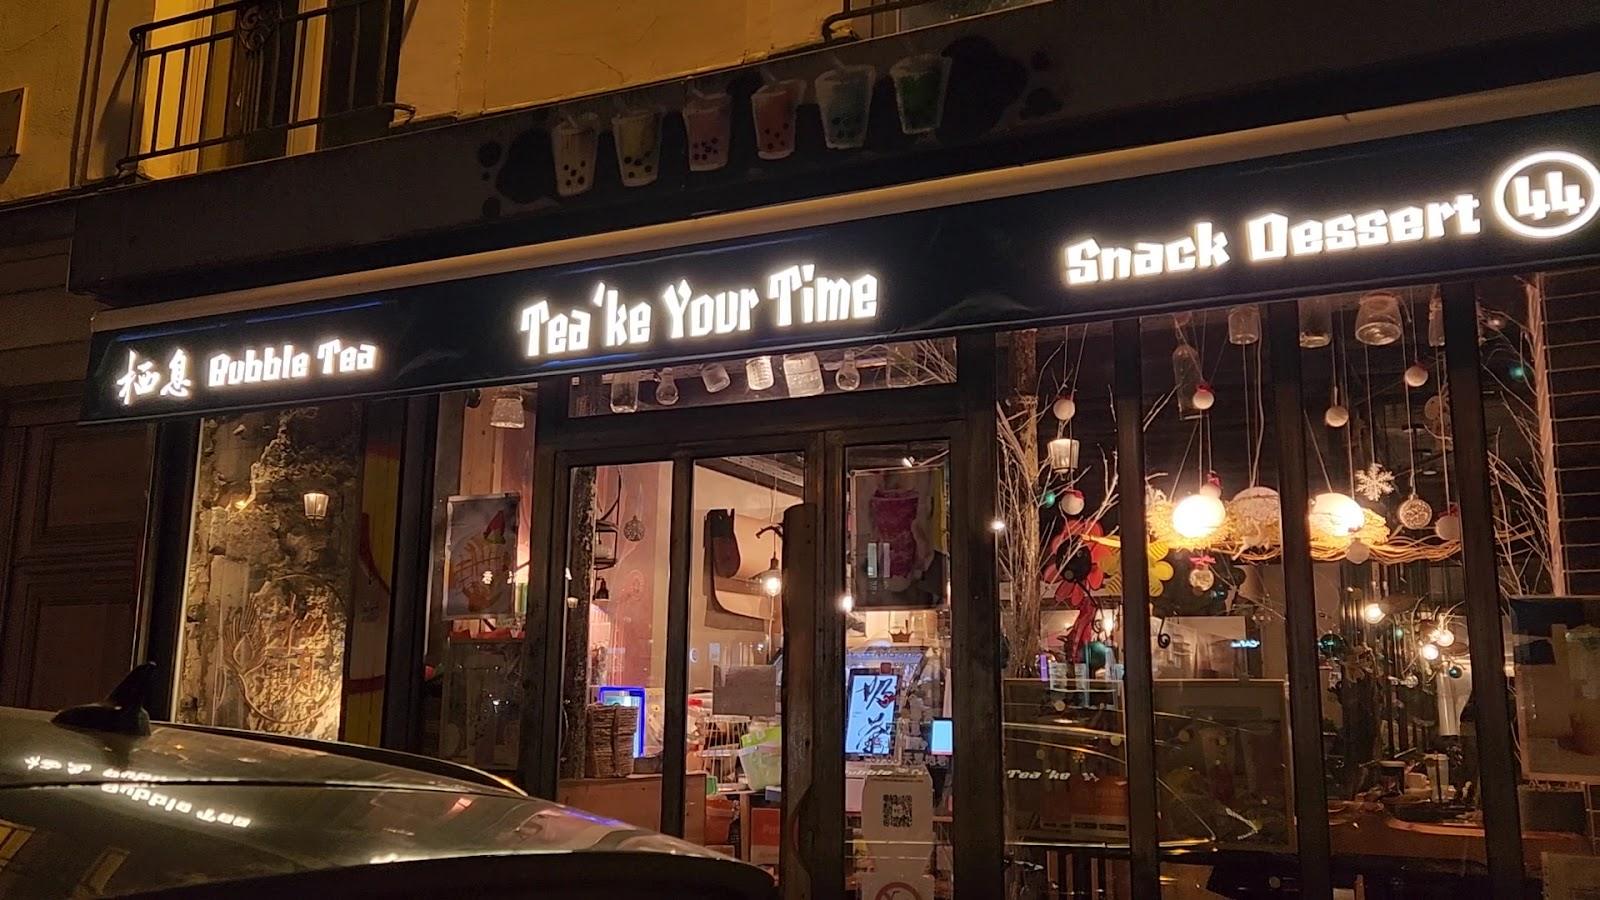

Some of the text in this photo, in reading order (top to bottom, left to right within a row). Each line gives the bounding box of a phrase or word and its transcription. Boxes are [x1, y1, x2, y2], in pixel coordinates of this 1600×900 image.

[1515, 171, 1586, 221] 44
[1065, 193, 1481, 284] Snack Dessert
[662, 279, 760, 339] Your
[767, 263, 878, 327] Time
[116, 348, 192, 405] 栖息
[208, 338, 377, 387] Bubble Tea
